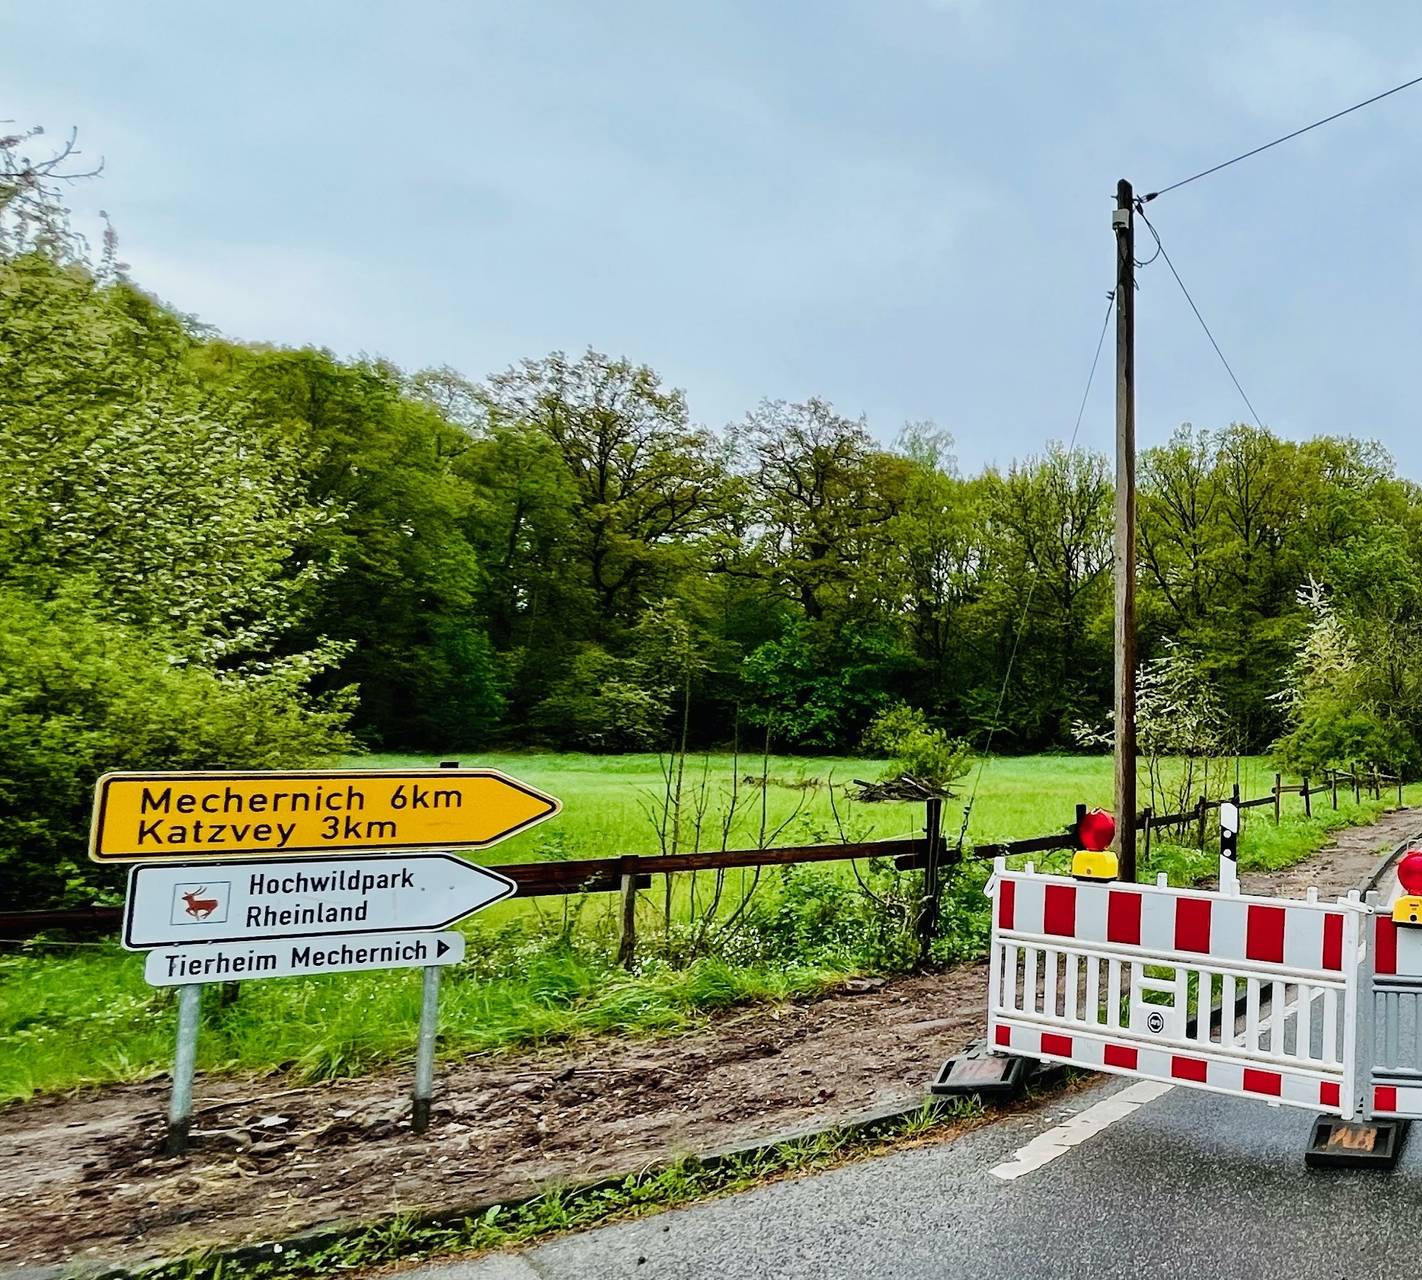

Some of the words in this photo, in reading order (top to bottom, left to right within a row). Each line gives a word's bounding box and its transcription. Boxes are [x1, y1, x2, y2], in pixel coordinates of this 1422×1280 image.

[140, 785, 365, 815] Mechernich
[390, 784, 462, 810] 6km
[137, 819, 297, 848] Katzvey
[320, 815, 397, 840] 3km
[249, 867, 414, 897] Hochwildpark
[246, 900, 368, 928] Rheinland
[165, 950, 277, 977] Tierheim
[291, 939, 427, 969] Mechernich
